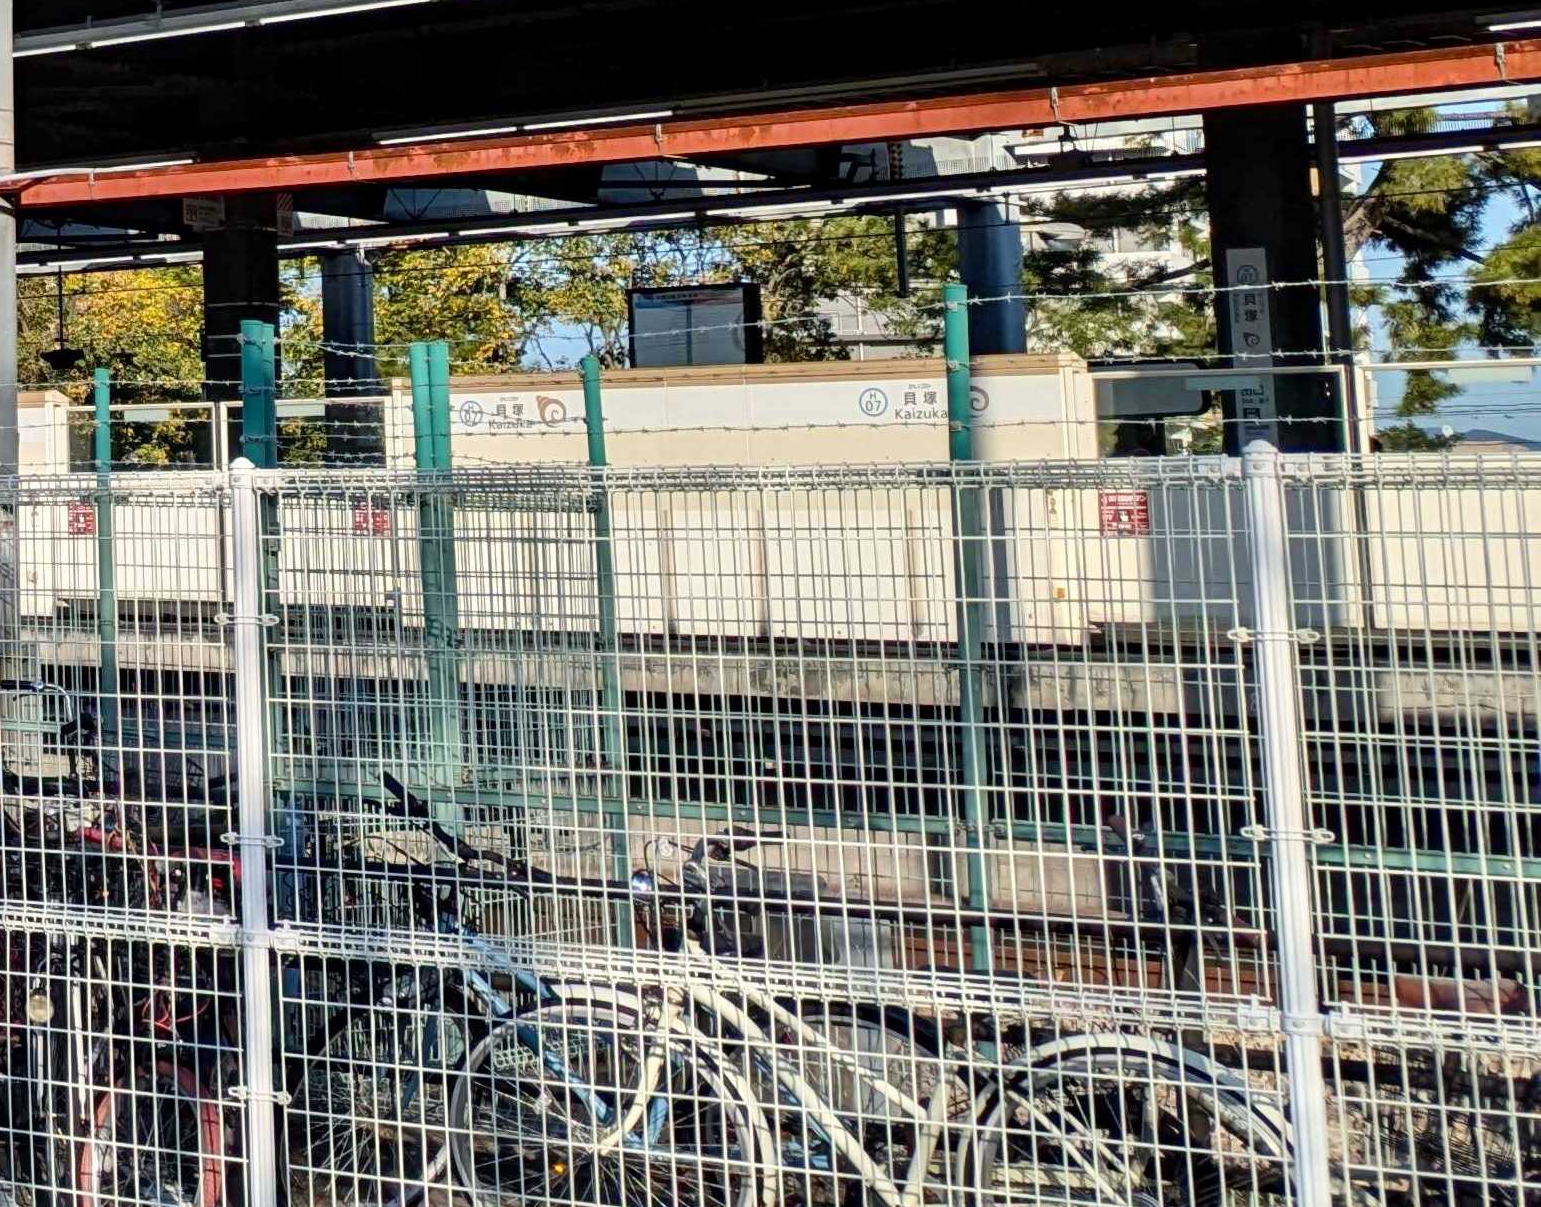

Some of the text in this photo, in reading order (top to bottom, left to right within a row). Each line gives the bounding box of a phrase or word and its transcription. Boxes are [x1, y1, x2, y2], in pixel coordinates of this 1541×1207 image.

[903, 391, 937, 405] 貝塚
[865, 400, 882, 412] 07
[894, 409, 948, 420] Kaizuka
